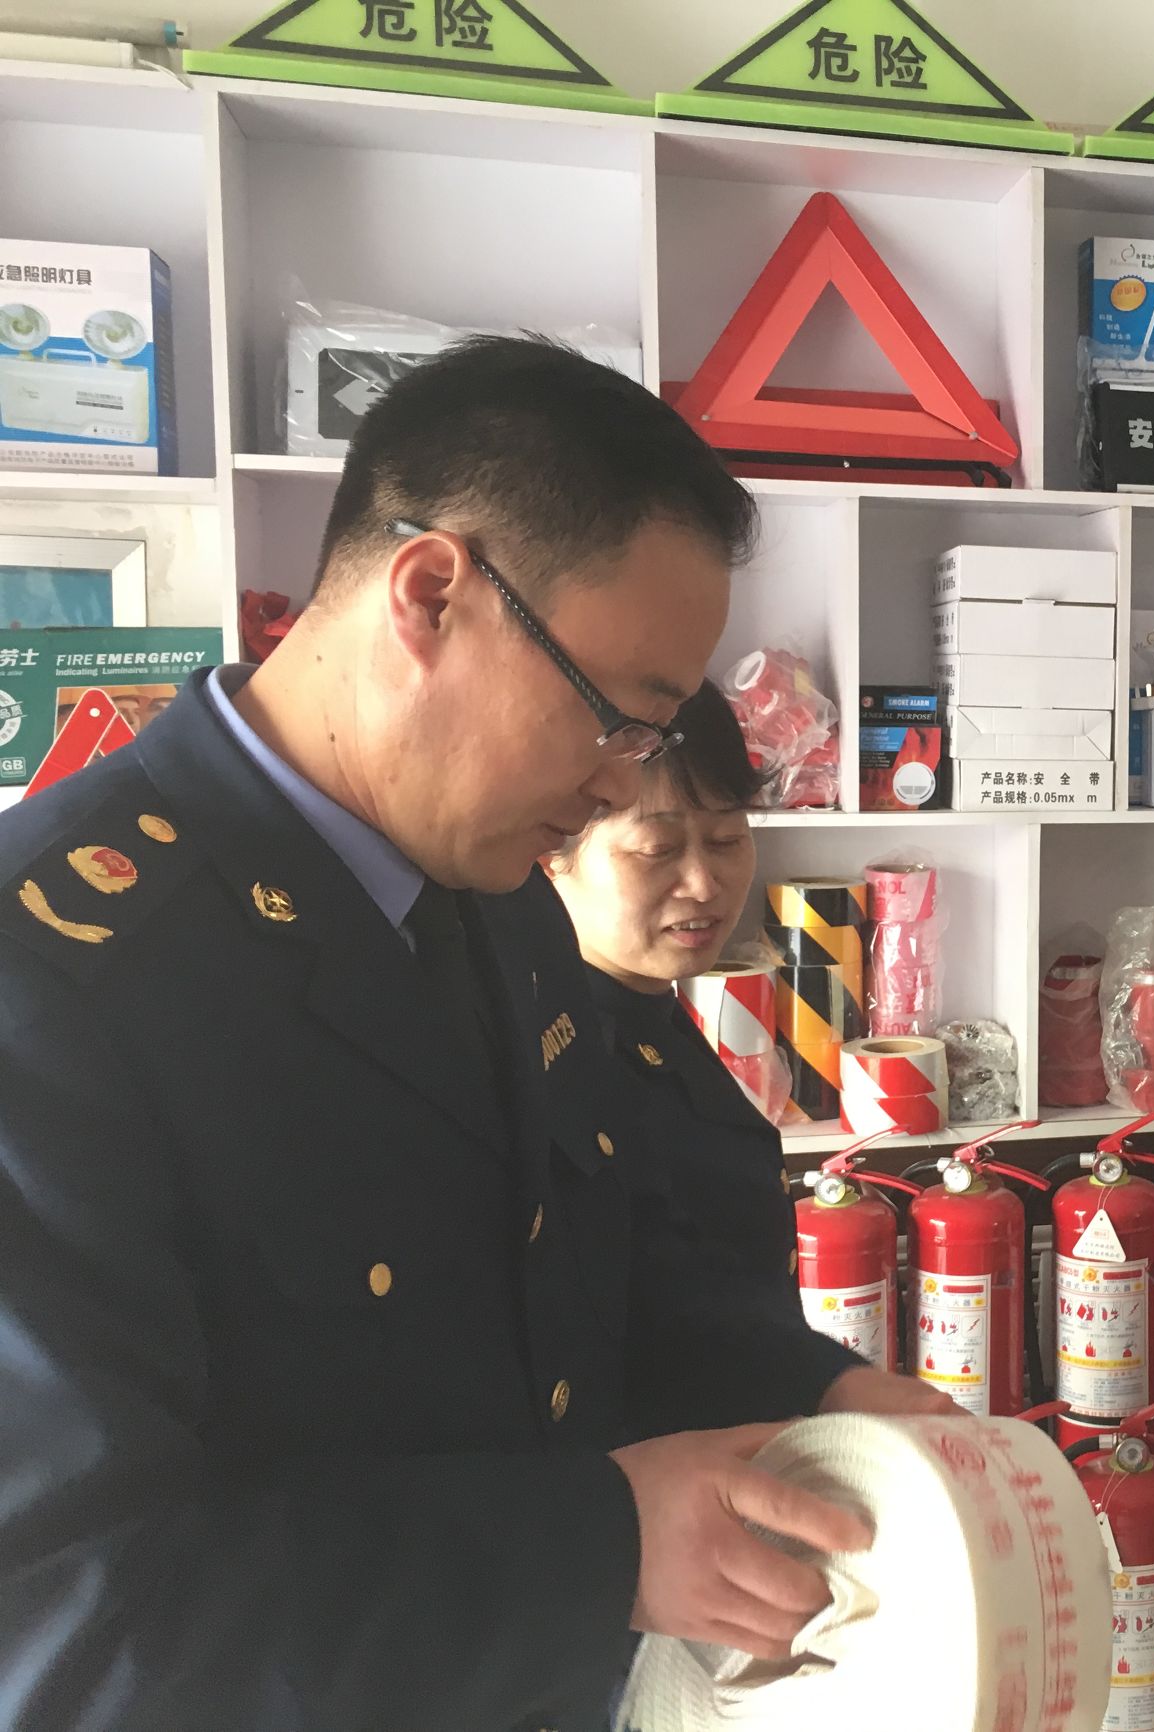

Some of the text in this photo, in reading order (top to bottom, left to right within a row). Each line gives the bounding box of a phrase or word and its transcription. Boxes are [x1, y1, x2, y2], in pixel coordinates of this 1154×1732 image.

[358, 0, 493, 50] 危险
[806, 27, 928, 91] 危险
[0, 264, 93, 286] 急照明灯具
[56, 651, 206, 666] FIRE EMERGENCY
[56, 666, 149, 677] Indicating Luminaires
[910, 699, 930, 707] ALARM
[896, 713, 933, 721] PURPOSE
[2, 759, 24, 771] GB
